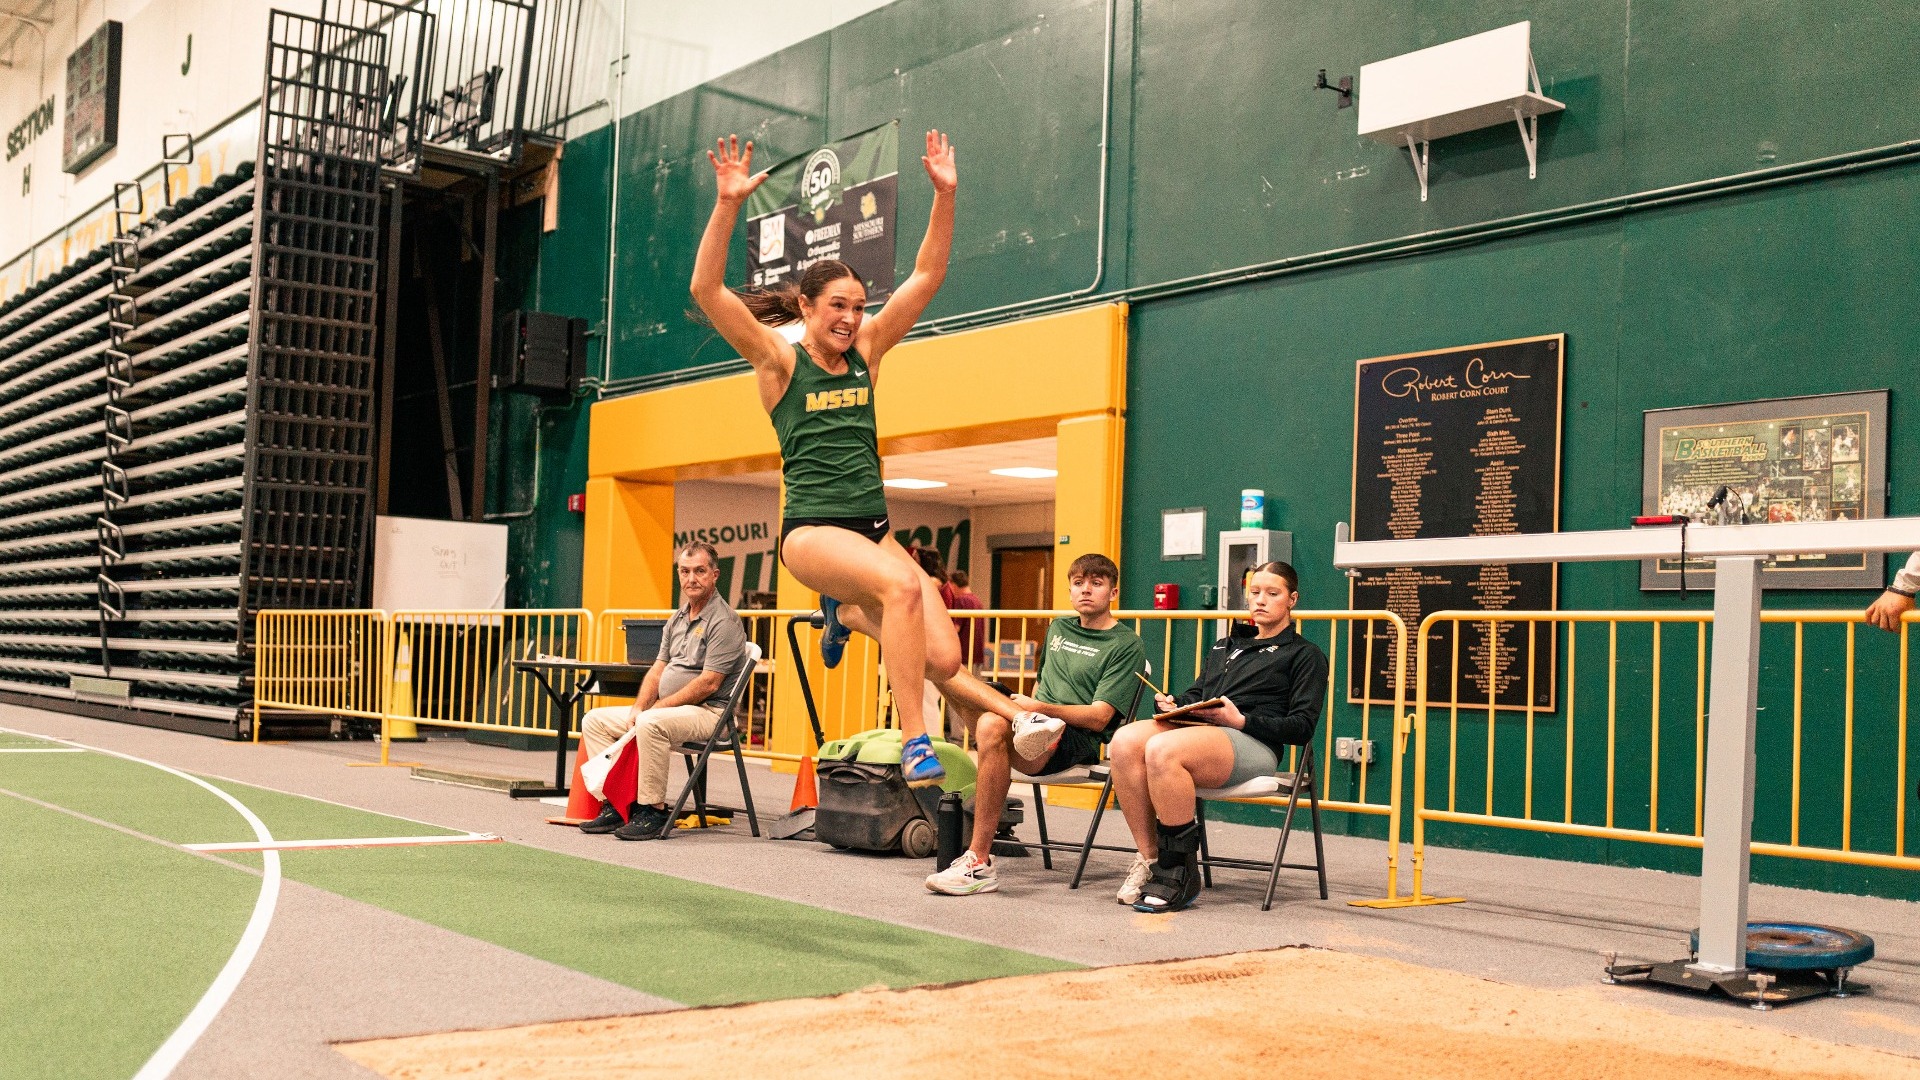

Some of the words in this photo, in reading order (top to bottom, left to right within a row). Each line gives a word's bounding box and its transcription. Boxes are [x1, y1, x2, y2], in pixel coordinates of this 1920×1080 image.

[181, 33, 192, 76] J
[6, 94, 55, 162] SECTION
[22, 163, 31, 197] H
[810, 167, 832, 194] 50
[1382, 367, 1458, 402] Robert
[1466, 358, 1531, 389] Corn
[1431, 391, 1458, 401] ROBERT
[1460, 389, 1480, 399] CORN
[1483, 386, 1509, 396] COURT
[805, 387, 869, 412] MSSU
[1674, 438, 1768, 461] BASKETBALL
[1696, 436, 1754, 448] SOUTHERN
[674, 522, 768, 549] MISSOURI
